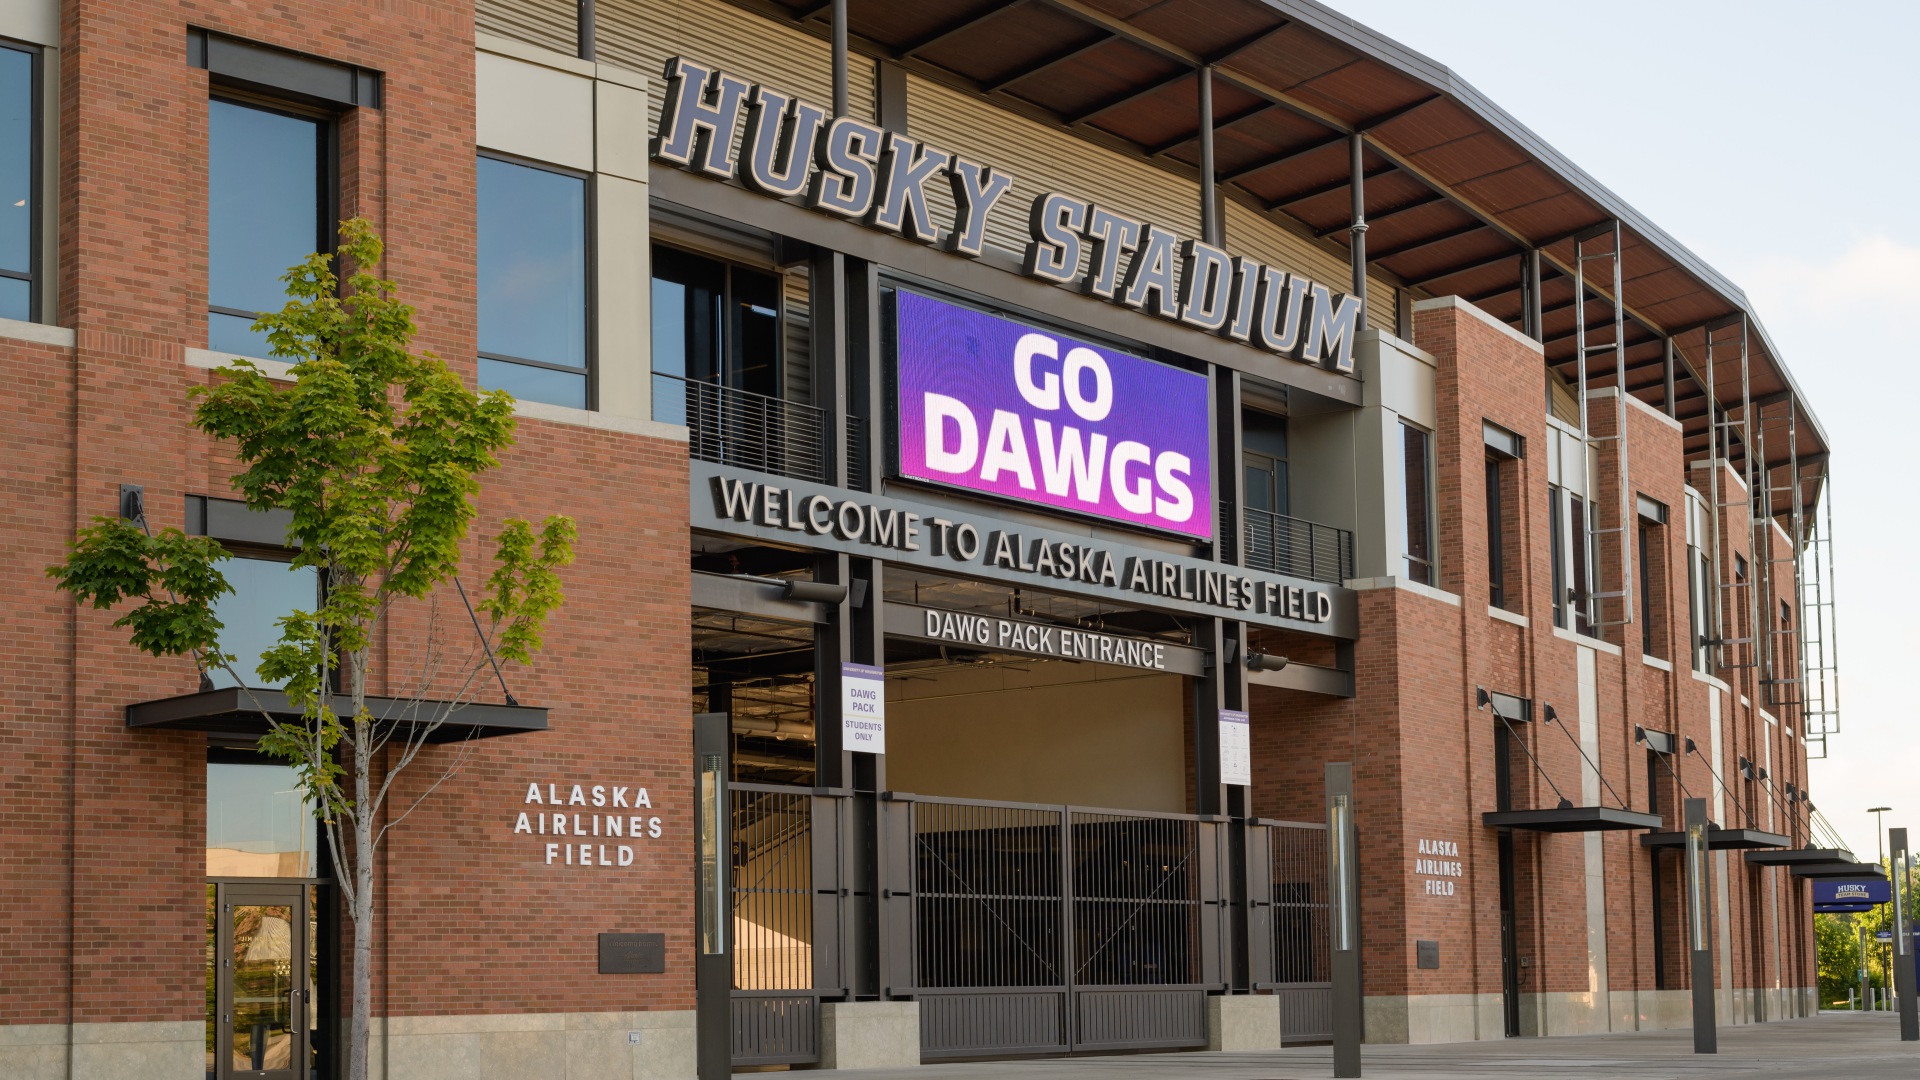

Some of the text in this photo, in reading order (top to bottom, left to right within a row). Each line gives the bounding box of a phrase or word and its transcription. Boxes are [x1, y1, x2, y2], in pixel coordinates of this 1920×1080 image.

[654, 56, 1363, 375] HUSKY STADIUM
[1013, 332, 1114, 422] GO
[924, 391, 1194, 523] DAWGS
[714, 475, 1332, 624] WELCOME TO ALASKA AIRLINES FIELD
[926, 609, 1165, 670] DAWG PACK ENTRANCE
[850, 688, 876, 700] DAWG
[852, 702, 875, 713] PACK
[845, 720, 882, 731] STUDENTS
[854, 732, 873, 741] ONLY
[525, 782, 652, 809] ALASKA
[513, 812, 662, 839] AIRLINES
[545, 843, 634, 867] FIELD
[1418, 839, 1459, 857] ALASKA
[1416, 859, 1462, 877] AIRLINES
[1425, 880, 1454, 896] FIELD
